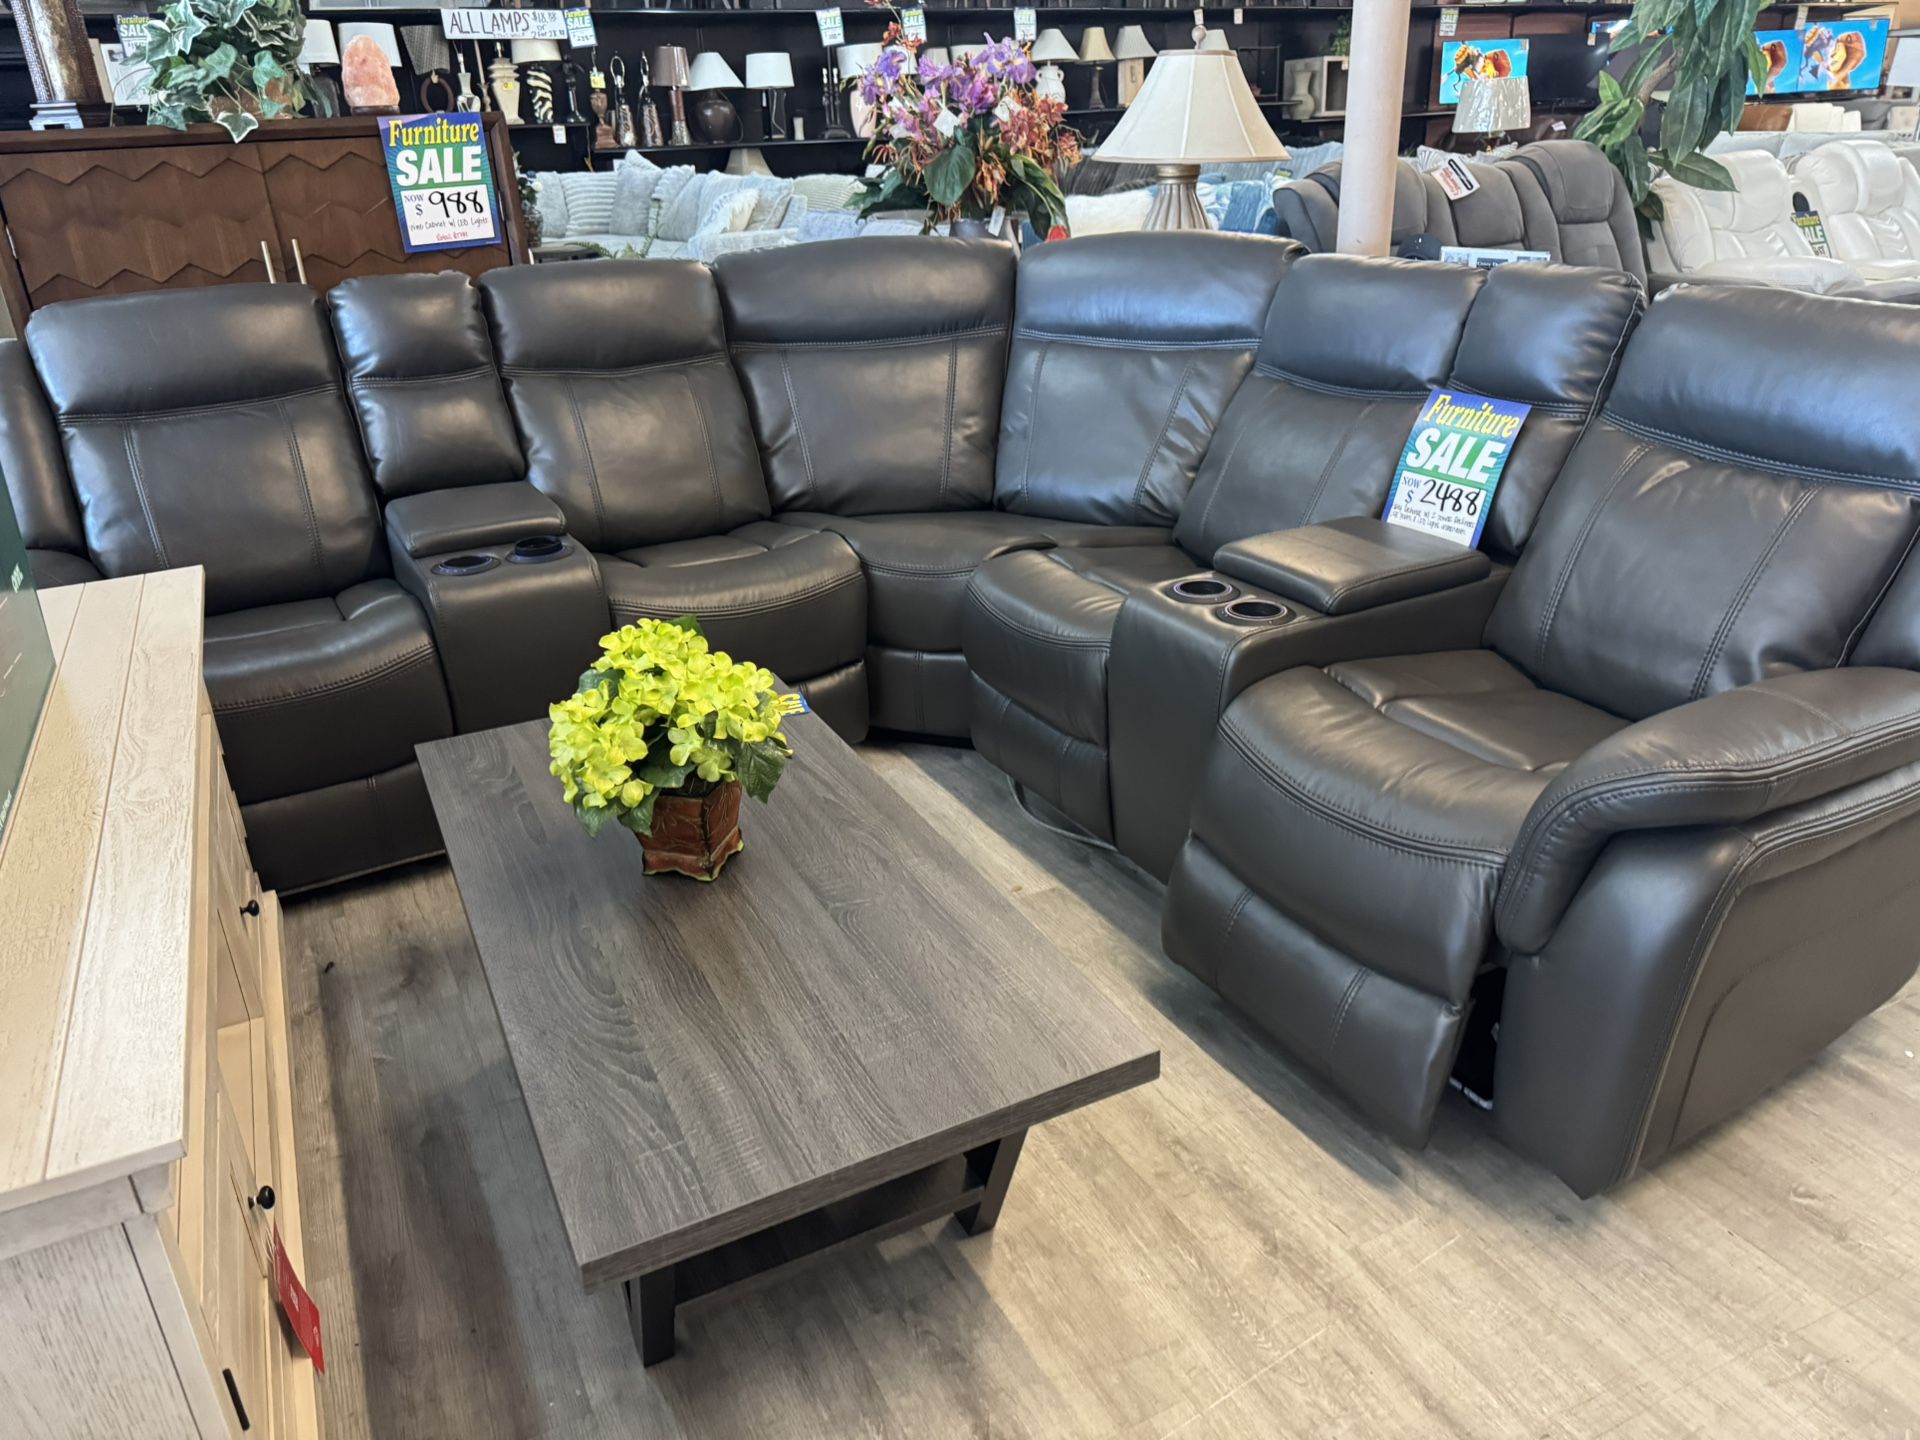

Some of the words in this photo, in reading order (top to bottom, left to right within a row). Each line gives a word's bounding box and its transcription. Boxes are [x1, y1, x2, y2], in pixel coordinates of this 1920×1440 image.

[120, 24, 148, 37] SAL
[450, 12, 479, 35] ALL
[480, 11, 530, 35] LAMPS
[567, 16, 592, 29] SALE
[820, 16, 841, 29] SALE
[903, 15, 924, 26] SALE
[388, 117, 480, 147] Furniture
[396, 145, 482, 187] SALE
[404, 193, 424, 203] NOW
[415, 203, 424, 216] $
[428, 190, 484, 218] 988
[1423, 394, 1520, 439] Furniture
[1405, 427, 1506, 485] SALE
[1402, 476, 1423, 489] NOW
[1404, 489, 1415, 505] $
[1420, 478, 1481, 517] 2488
